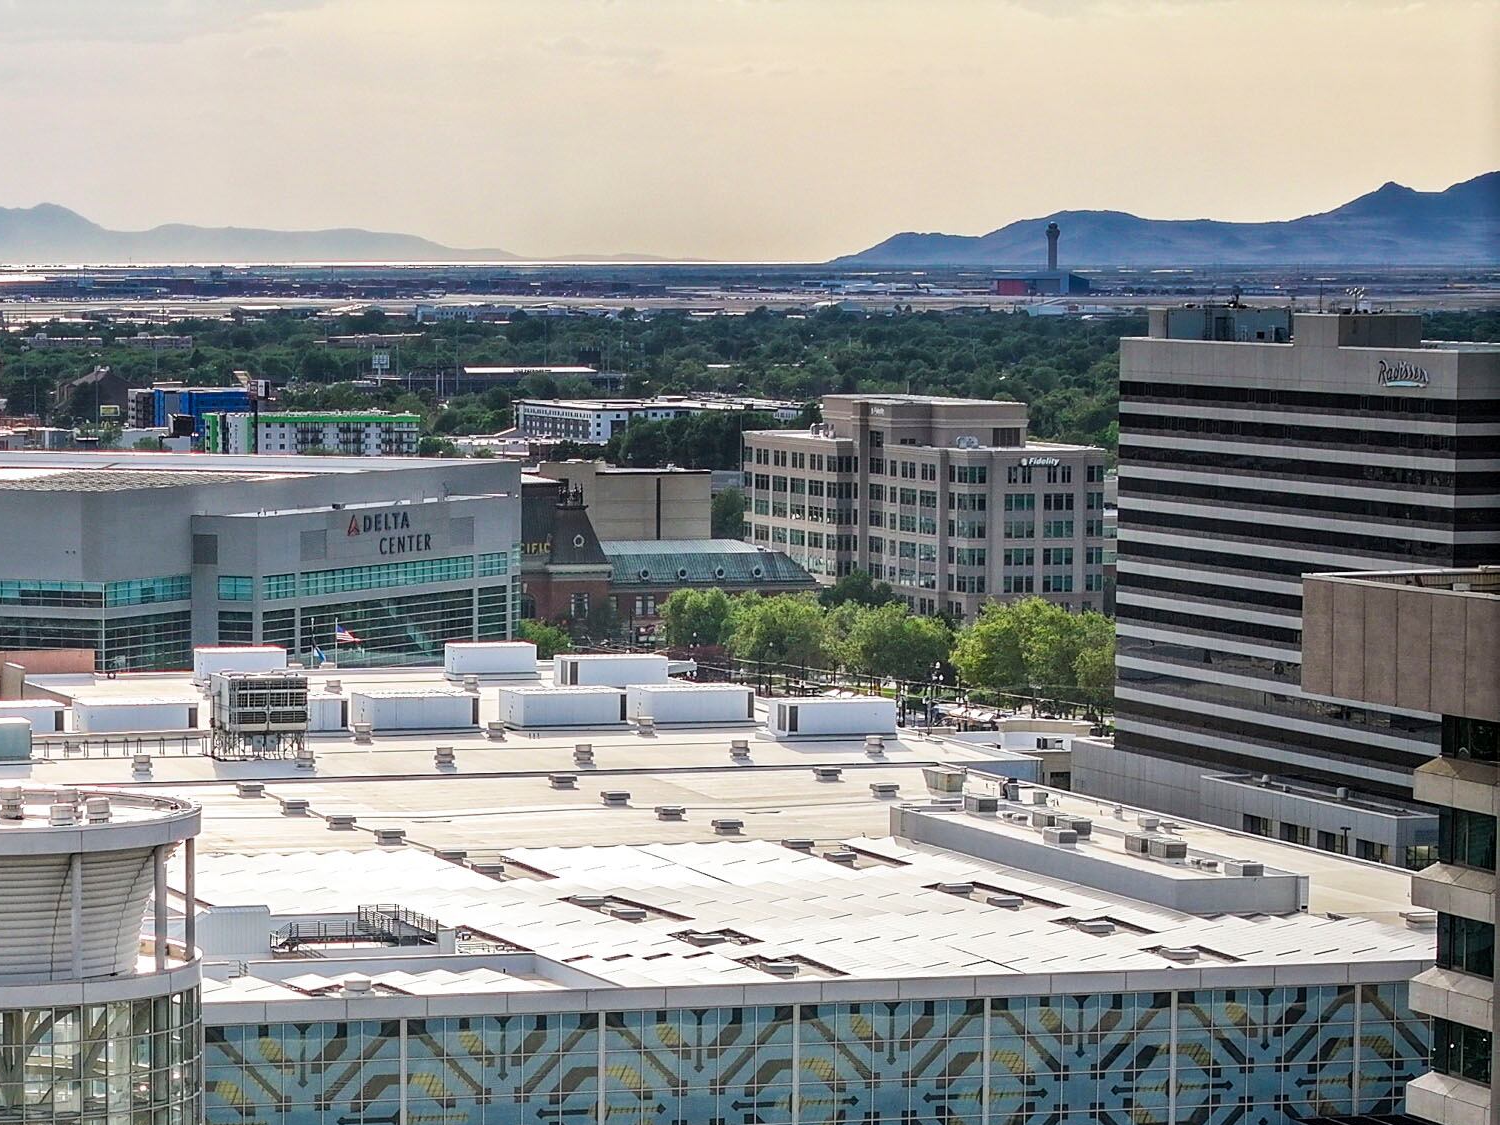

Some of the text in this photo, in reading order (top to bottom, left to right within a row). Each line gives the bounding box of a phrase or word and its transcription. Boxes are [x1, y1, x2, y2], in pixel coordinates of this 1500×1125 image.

[1029, 457, 1060, 466] Fidelity
[363, 511, 410, 532] DELTA
[379, 534, 432, 555] CENTER
